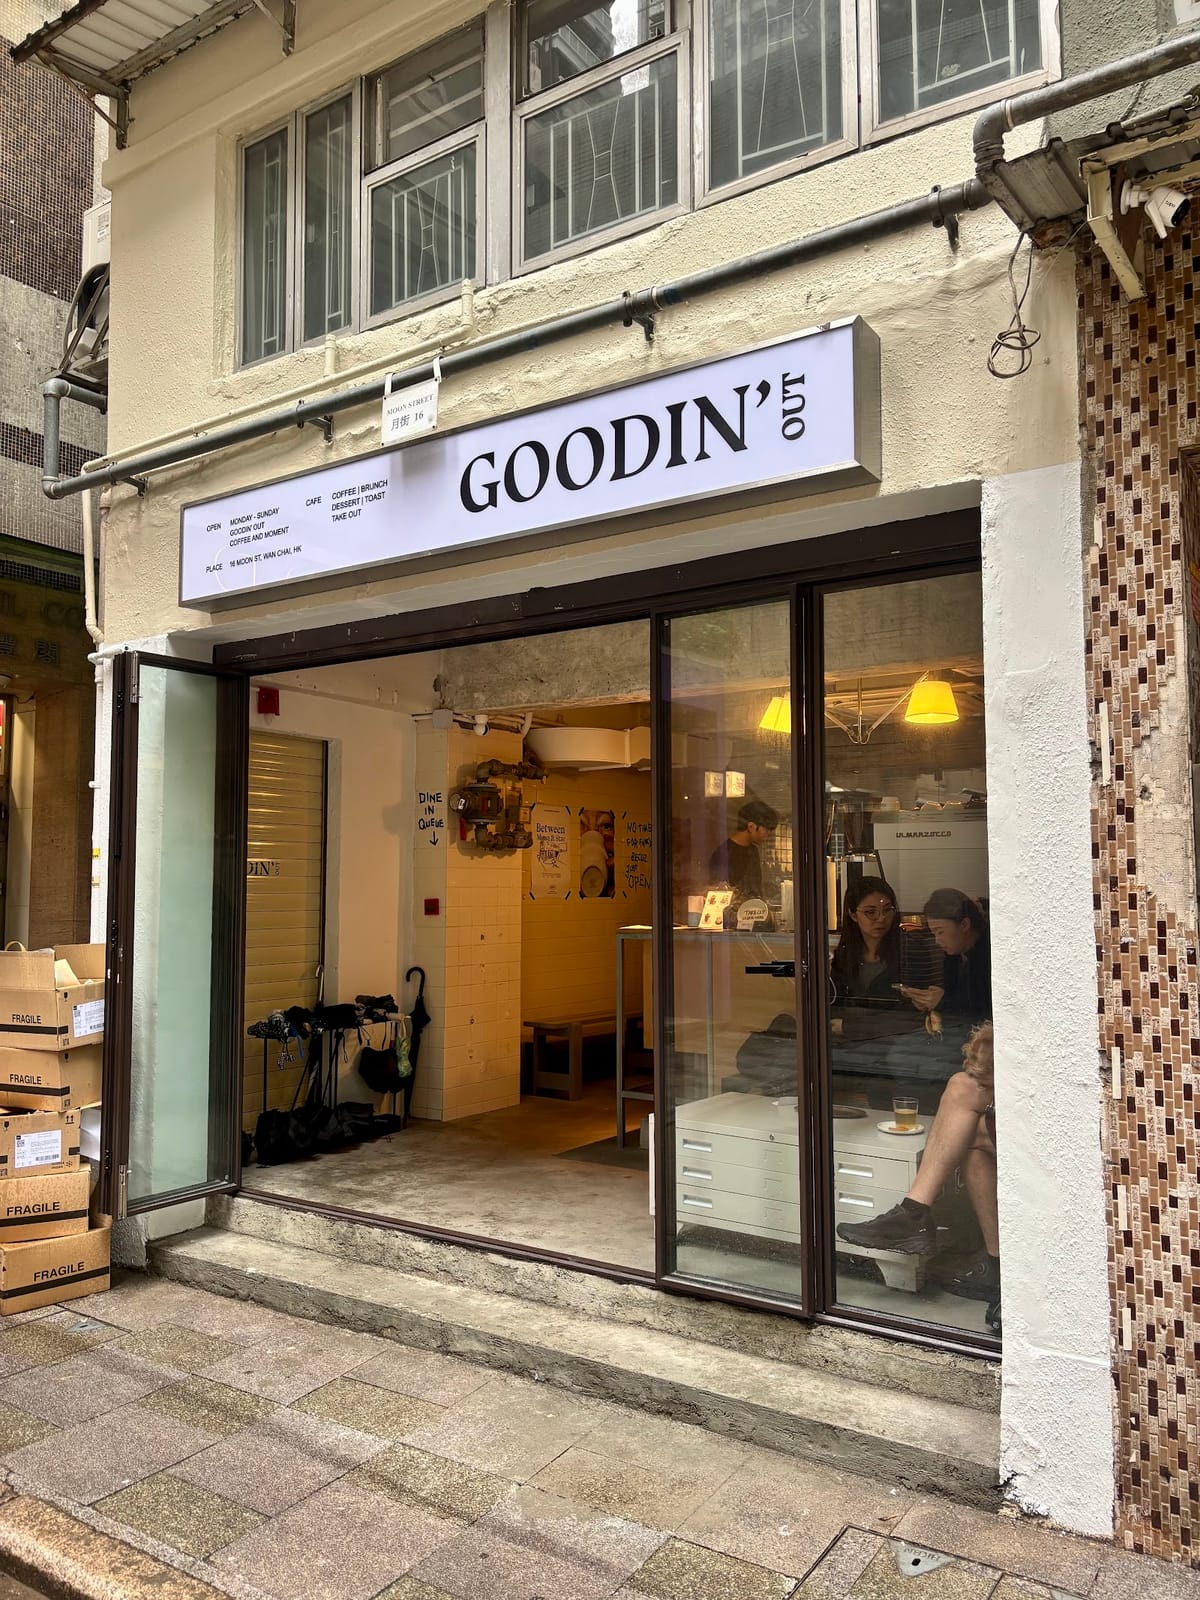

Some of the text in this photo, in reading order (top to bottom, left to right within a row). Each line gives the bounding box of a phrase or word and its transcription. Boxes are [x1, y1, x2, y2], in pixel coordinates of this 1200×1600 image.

[386, 394, 434, 416] MOON STREET
[781, 372, 805, 440] OUT
[391, 410, 424, 431] 月街 16
[459, 379, 771, 513] GOODIN'
[305, 496, 322, 507] CAFE
[331, 487, 357, 500] COFFEE
[360, 479, 388, 493] BRUNCH
[331, 497, 360, 511] DESSERT
[364, 491, 386, 503] TOAST
[206, 522, 221, 532] OPEN
[230, 514, 253, 526] MONDAY
[256, 507, 280, 519] SUNDAY
[331, 508, 362, 522] TAKE OUT
[229, 521, 265, 536] GOODIN' OUT
[229, 526, 289, 547] COFFEE AND MOMENT
[205, 563, 223, 573] PLACE
[236, 556, 253, 566] MOON
[263, 551, 276, 560] WAN
[276, 547, 292, 557] CHAI,
[293, 544, 302, 553] HK
[418, 791, 442, 804] DINE
[424, 804, 435, 815] IN
[418, 817, 445, 830] QUEUE
[536, 823, 566, 834] Between
[11, 1013, 42, 1025] FRAGILE
[9, 1073, 42, 1085] FRAGILE
[6, 1201, 61, 1217] FRAGILE
[33, 1261, 85, 1282] FRAGILE
